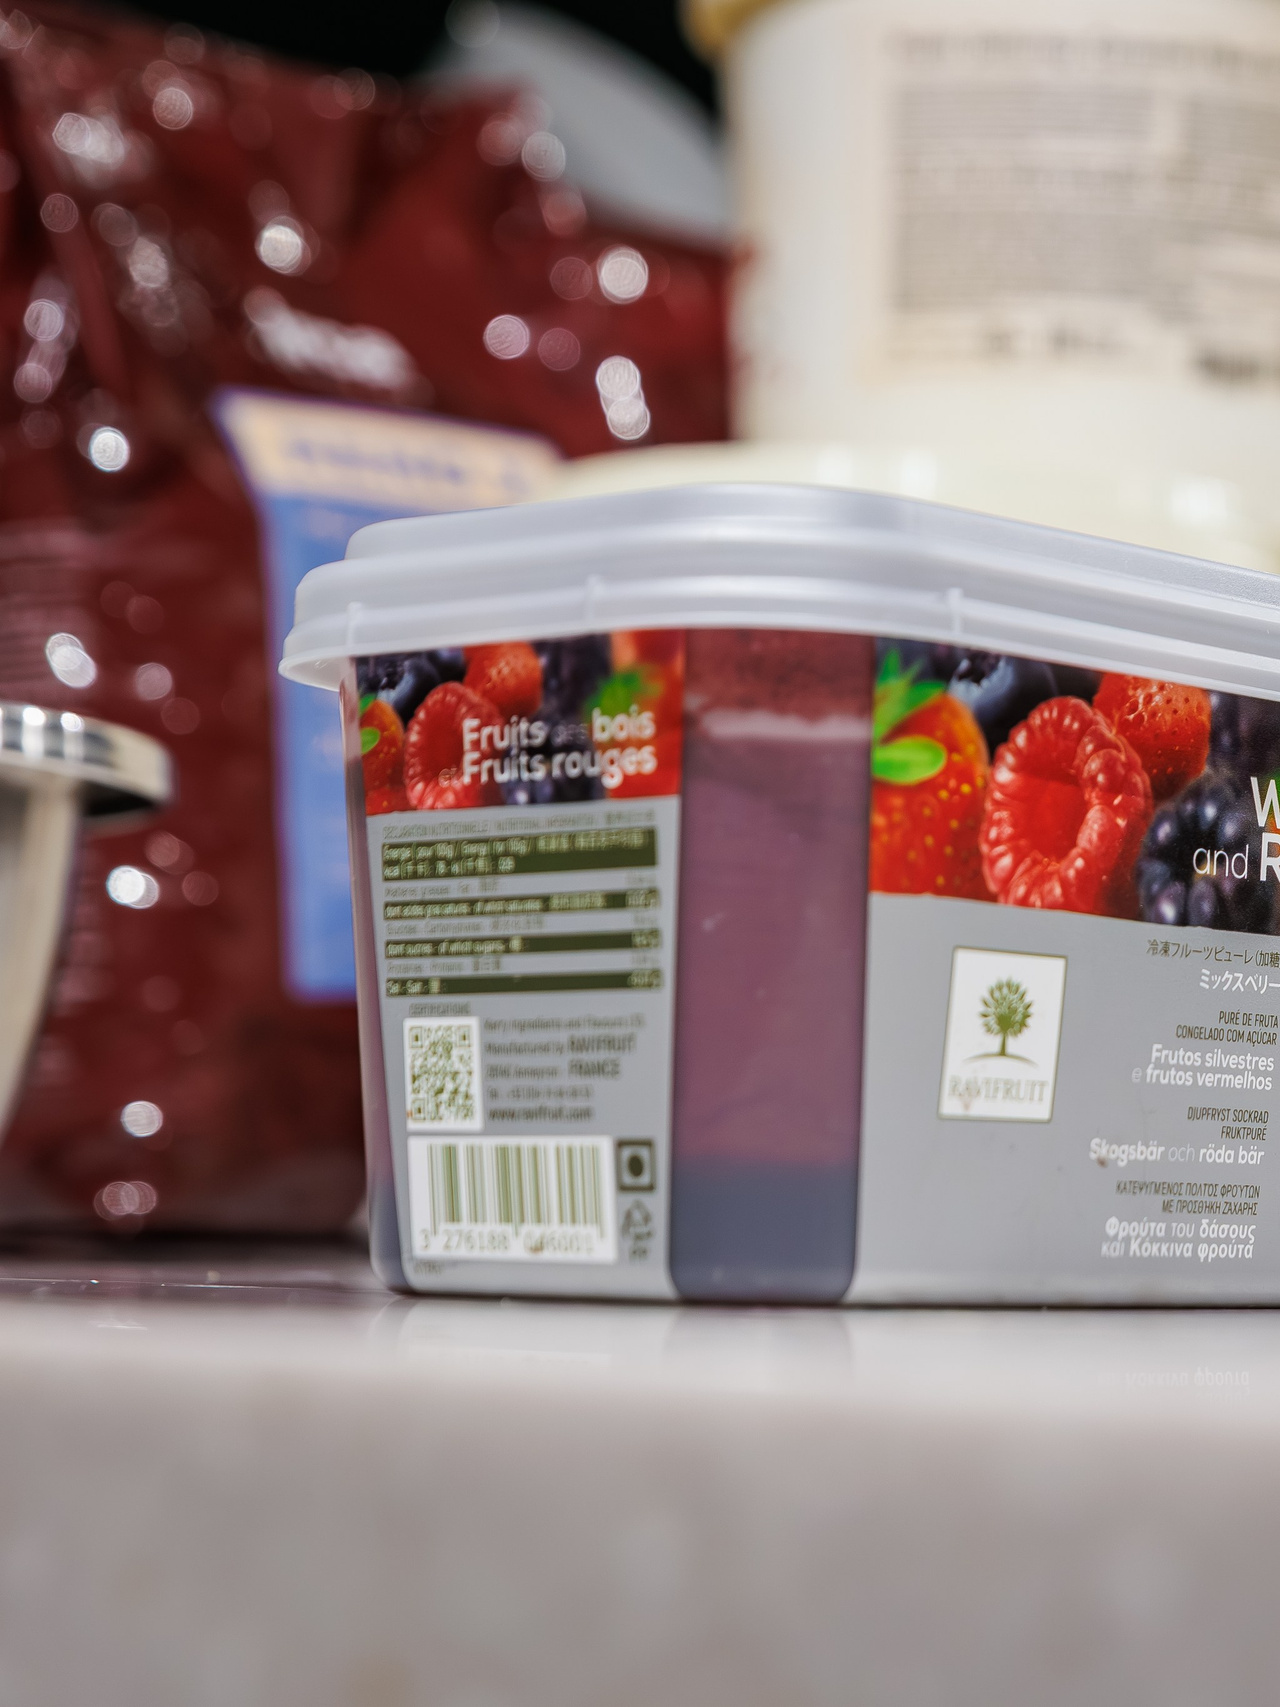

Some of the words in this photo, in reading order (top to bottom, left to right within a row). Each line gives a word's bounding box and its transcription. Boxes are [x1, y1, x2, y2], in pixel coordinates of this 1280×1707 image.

[463, 715, 548, 750] Fruits
[592, 704, 656, 742] bois
[462, 751, 547, 785] Fruits
[552, 745, 657, 789] rouges
[1193, 845, 1249, 879] and
[1200, 968, 1280, 994] ミックスベリー
[1219, 1009, 1240, 1025] PURÉ
[1242, 1012, 1252, 1026] DE
[1254, 1013, 1278, 1028] FRUTA
[1176, 1024, 1225, 1042] CONGELADO
[1227, 1028, 1244, 1043] COM
[1246, 1029, 1278, 1047] AÇÚCAR
[568, 1057, 621, 1080] FRANCE
[1151, 1043, 1201, 1067] Frutos
[1205, 1049, 1274, 1071] silvestres
[1131, 1067, 1142, 1083] e
[1146, 1063, 1193, 1086] frutos
[1197, 1071, 1272, 1091] vermelhos
[1187, 1106, 1231, 1122] DJUPFRYST
[1232, 1109, 1269, 1124] SOCKRAD
[1221, 1125, 1267, 1141] FRUKTPURÉ
[1089, 1138, 1166, 1167] Skogsbär
[1168, 1143, 1195, 1162] och
[1199, 1144, 1234, 1164] röda
[1238, 1145, 1265, 1165] bär
[1162, 1199, 1174, 1214] ΜΕ
[419, 1228, 430, 1251] 3
[1105, 1215, 1167, 1241] Φρούτα
[1171, 1222, 1195, 1238] του
[1200, 1219, 1256, 1243] δάσους
[1101, 1241, 1125, 1258] και
[1129, 1237, 1193, 1258] Κόκκινα
[1197, 1239, 1254, 1262] φρούτα
